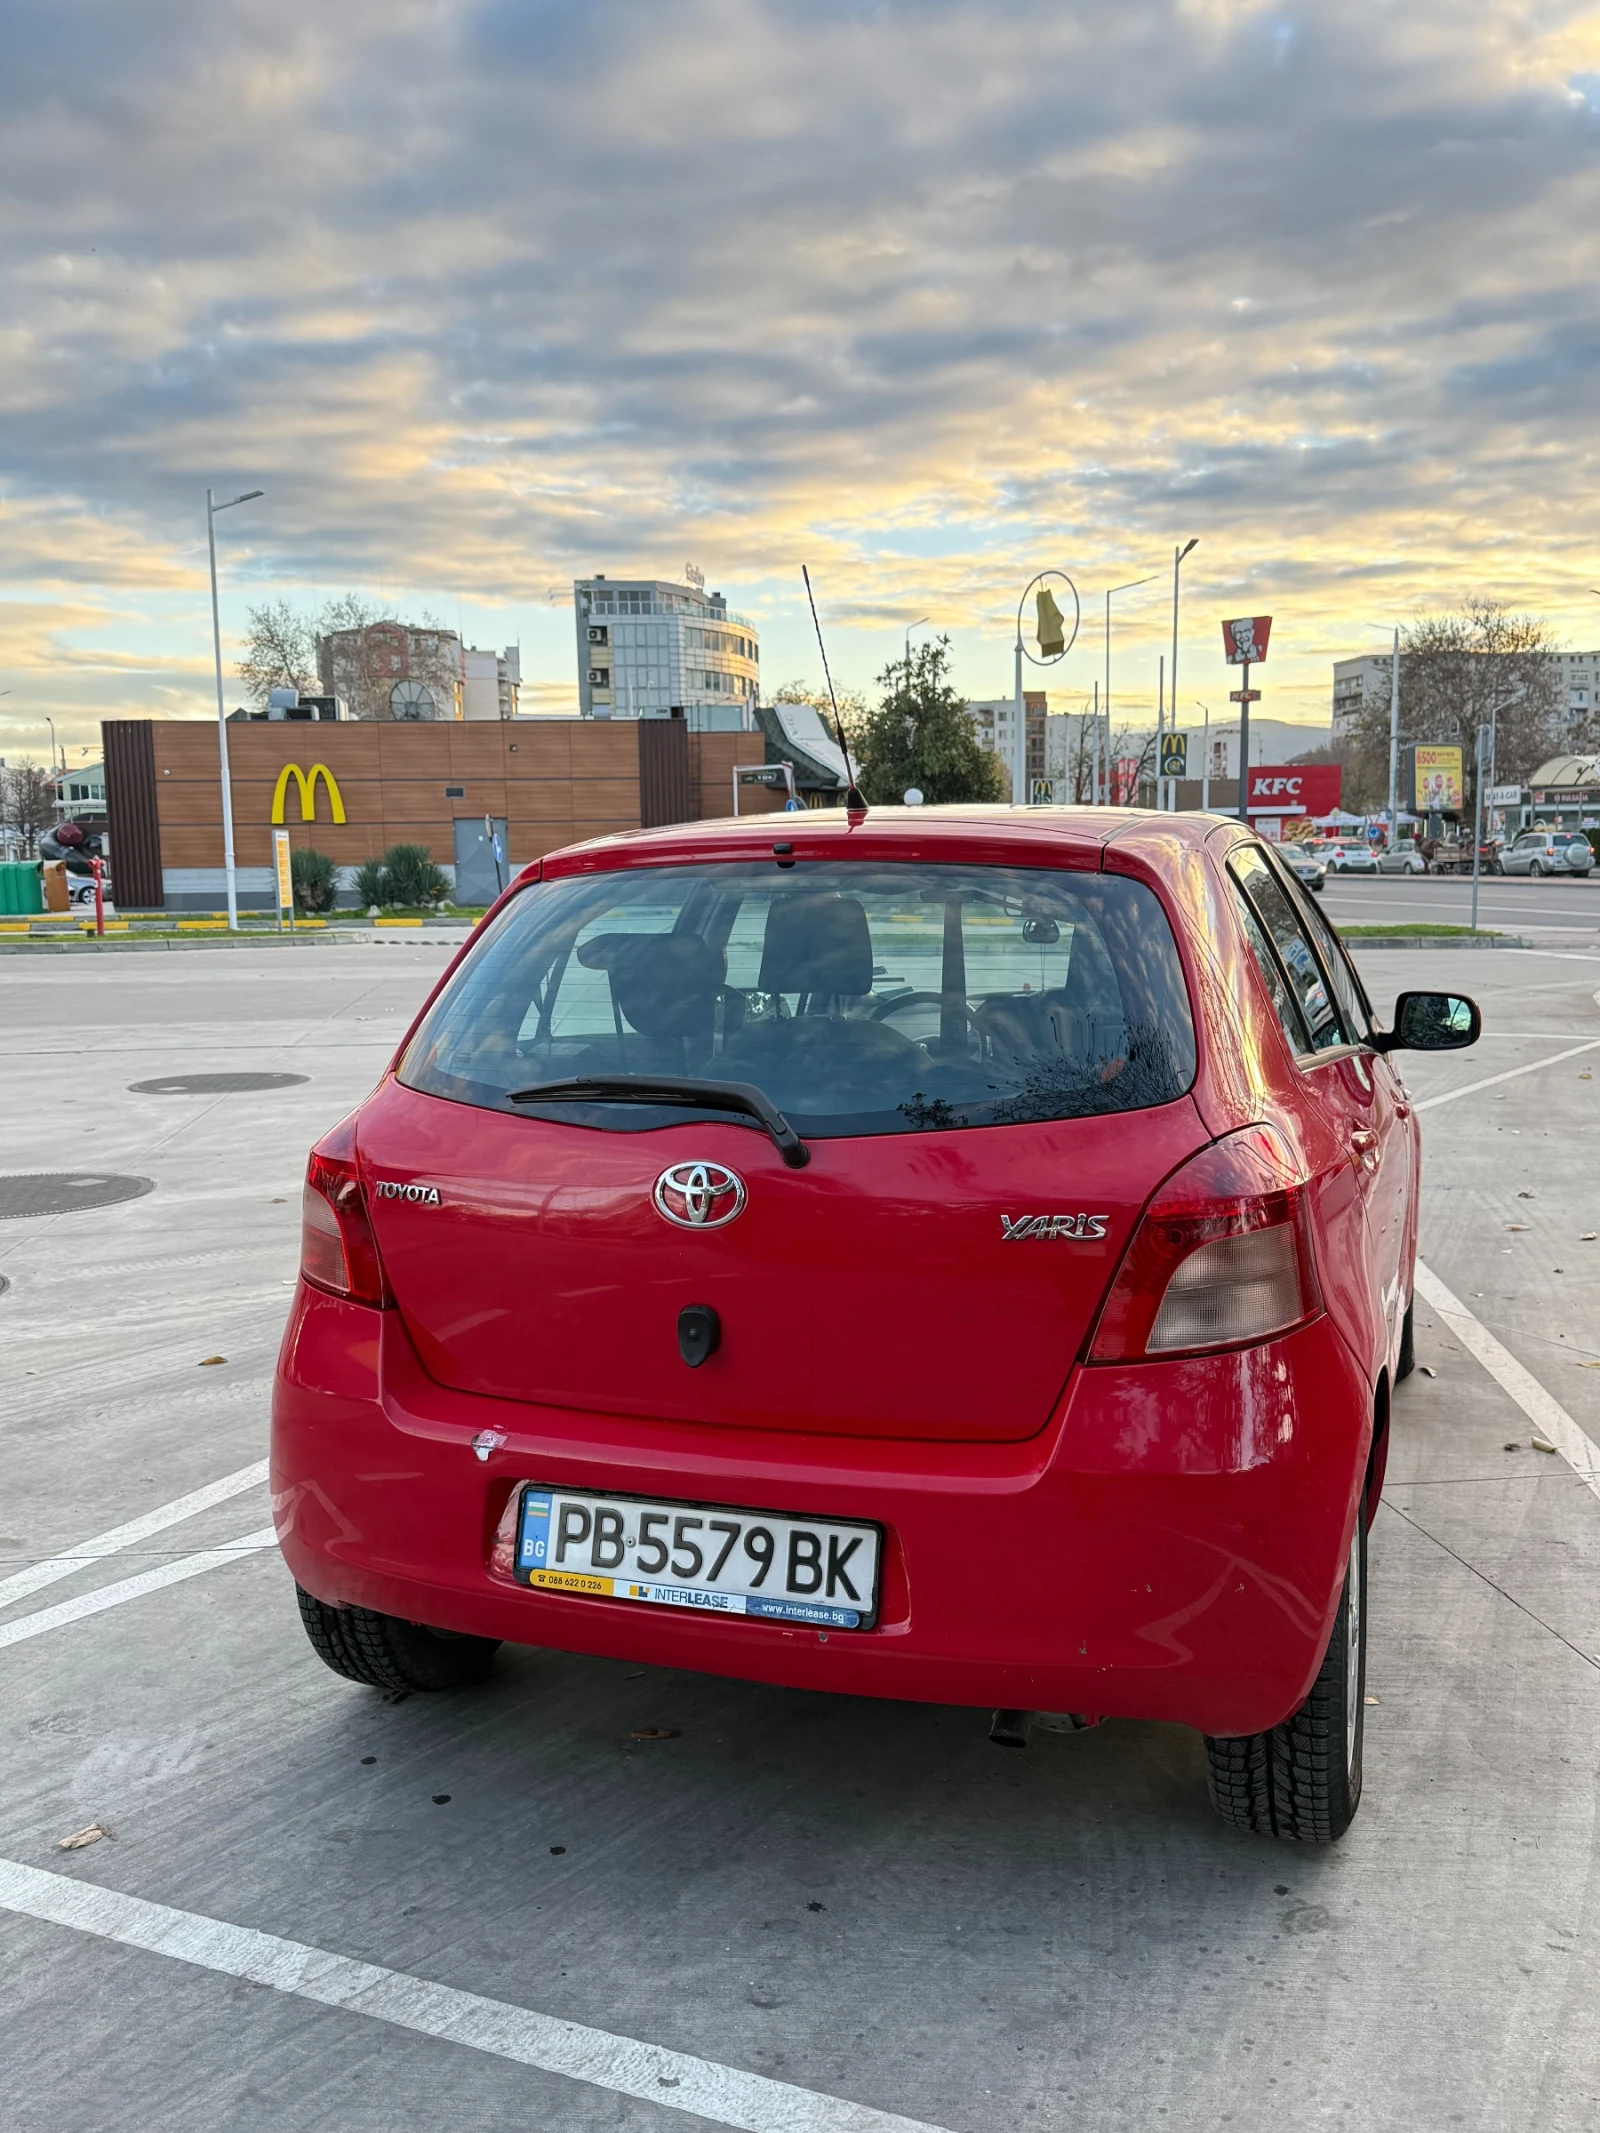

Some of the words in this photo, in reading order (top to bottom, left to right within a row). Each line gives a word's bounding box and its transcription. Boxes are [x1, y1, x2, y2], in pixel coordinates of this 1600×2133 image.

[1252, 777, 1302, 796] KFC
[1561, 793, 1588, 801] BULGAIA
[376, 1181, 442, 1205] TOYOTA
[523, 1539, 545, 1557] BG
[637, 1512, 775, 1587] 5579
[785, 1530, 863, 1601] BK
[549, 1575, 563, 1585] 088
[565, 1578, 579, 1587] 622
[580, 1580, 586, 1588] 0
[587, 1580, 602, 1590] 226
[654, 1587, 729, 1608] INTERLEASE
[761, 1603, 845, 1624] www.interlease.bg
